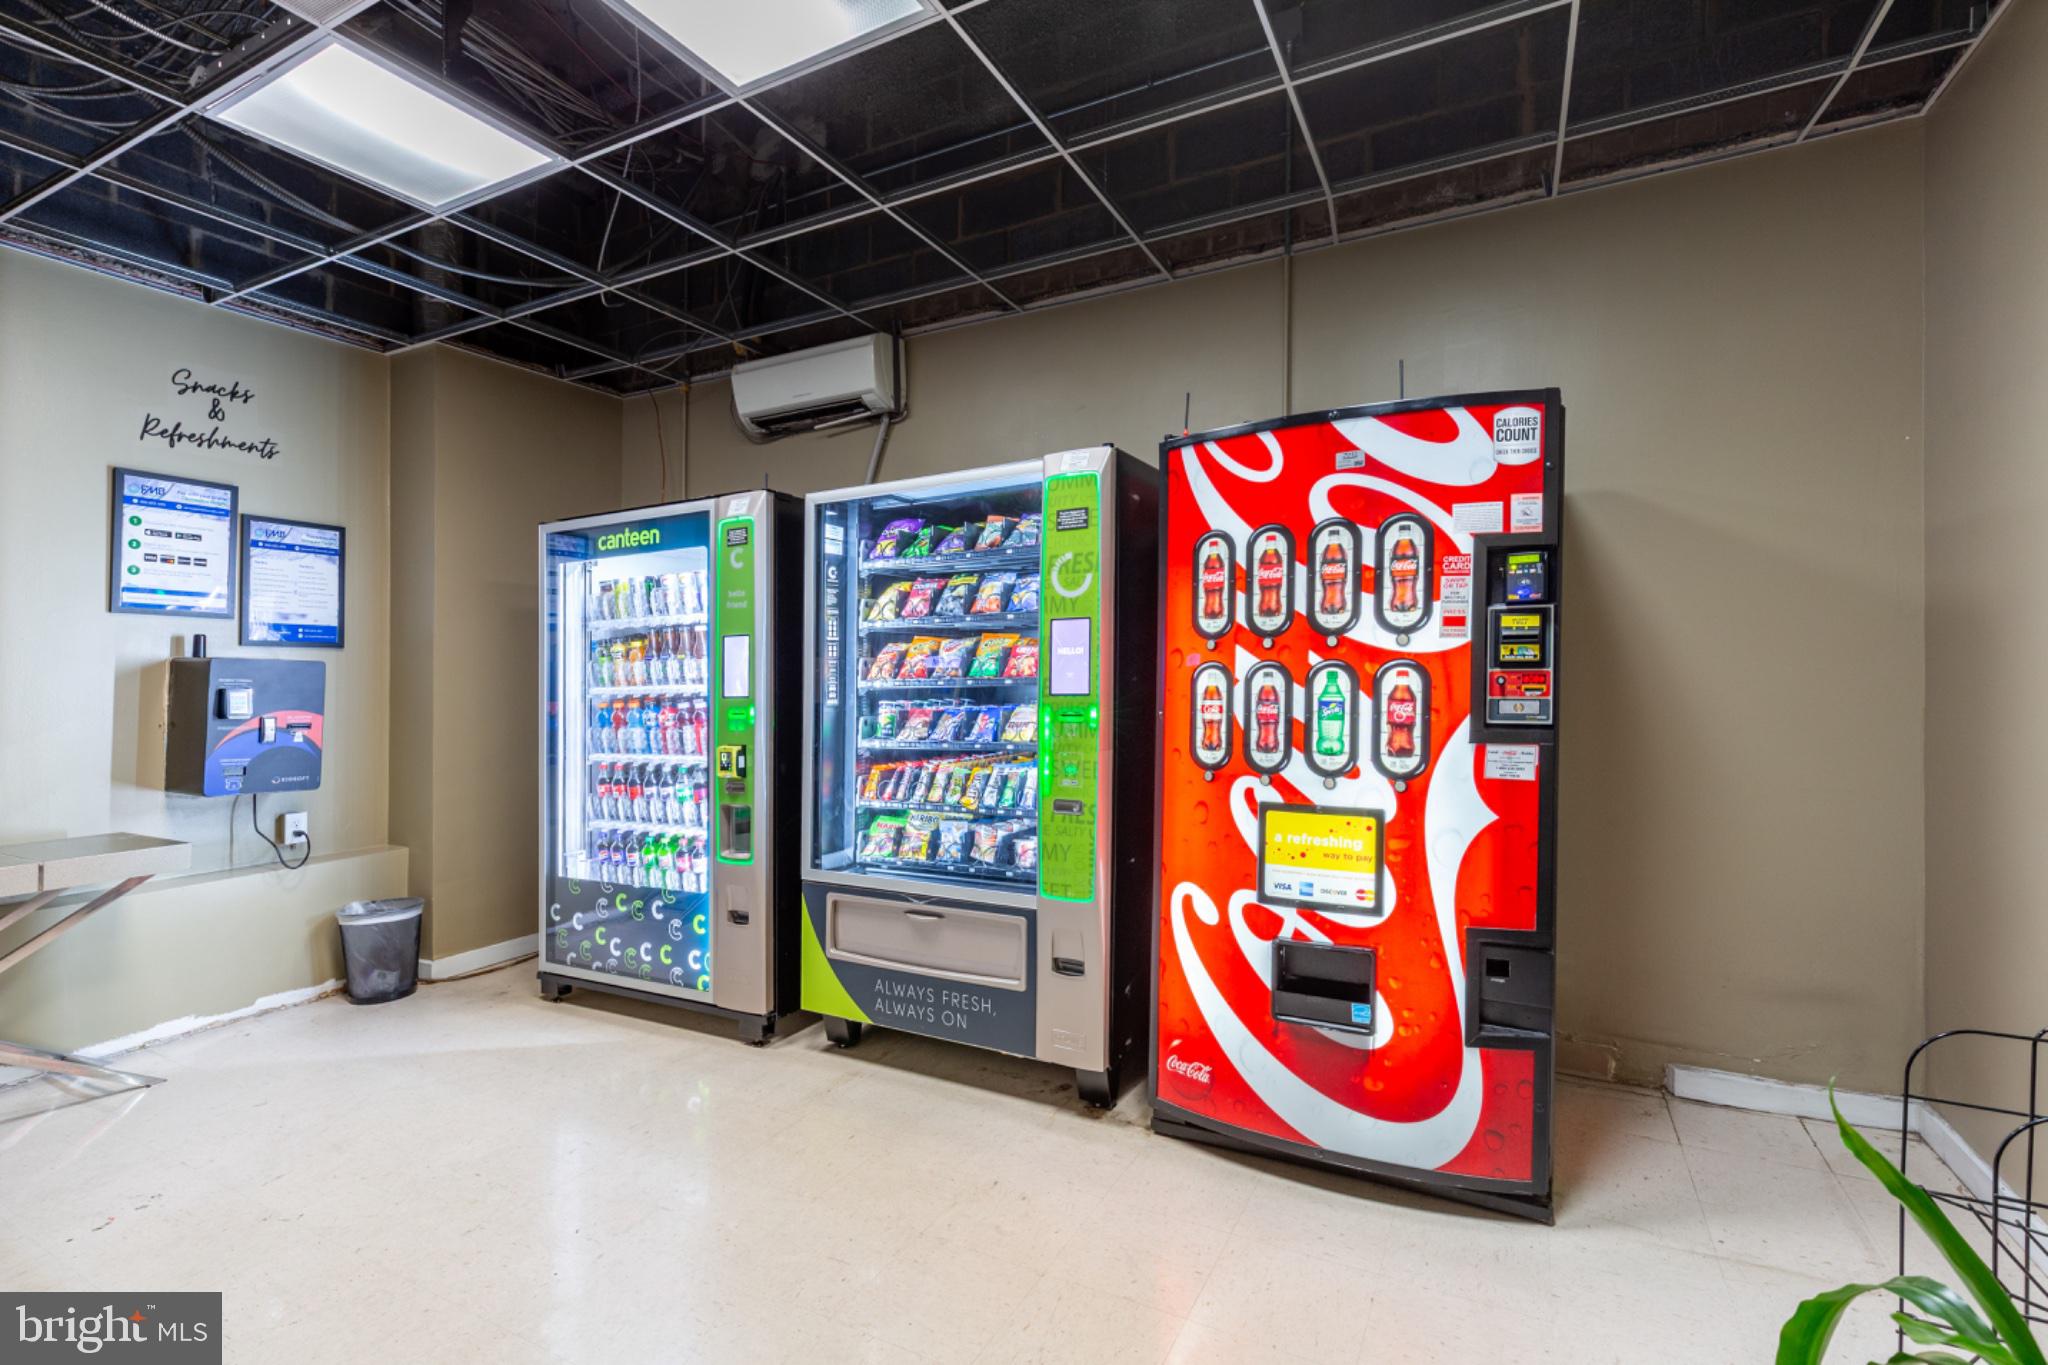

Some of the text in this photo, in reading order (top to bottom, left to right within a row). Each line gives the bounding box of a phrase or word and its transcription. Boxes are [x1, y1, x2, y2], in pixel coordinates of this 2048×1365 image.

[172, 368, 254, 404] Snacks
[208, 398, 226, 422] &
[1496, 416, 1538, 428] CALORIES
[140, 414, 280, 460] Refreshments
[1496, 428, 1538, 442] COUNT
[598, 526, 660, 552] canteen
[1274, 833, 1363, 852] a refreshing
[1322, 853, 1340, 862] way
[1356, 855, 1373, 864] pay
[1274, 882, 1292, 891] VISA
[874, 978, 998, 1017] ALWAYS FRESH,
[874, 997, 968, 1029] ALWAYS ON
[1166, 1055, 1212, 1083] Coca-Cola
